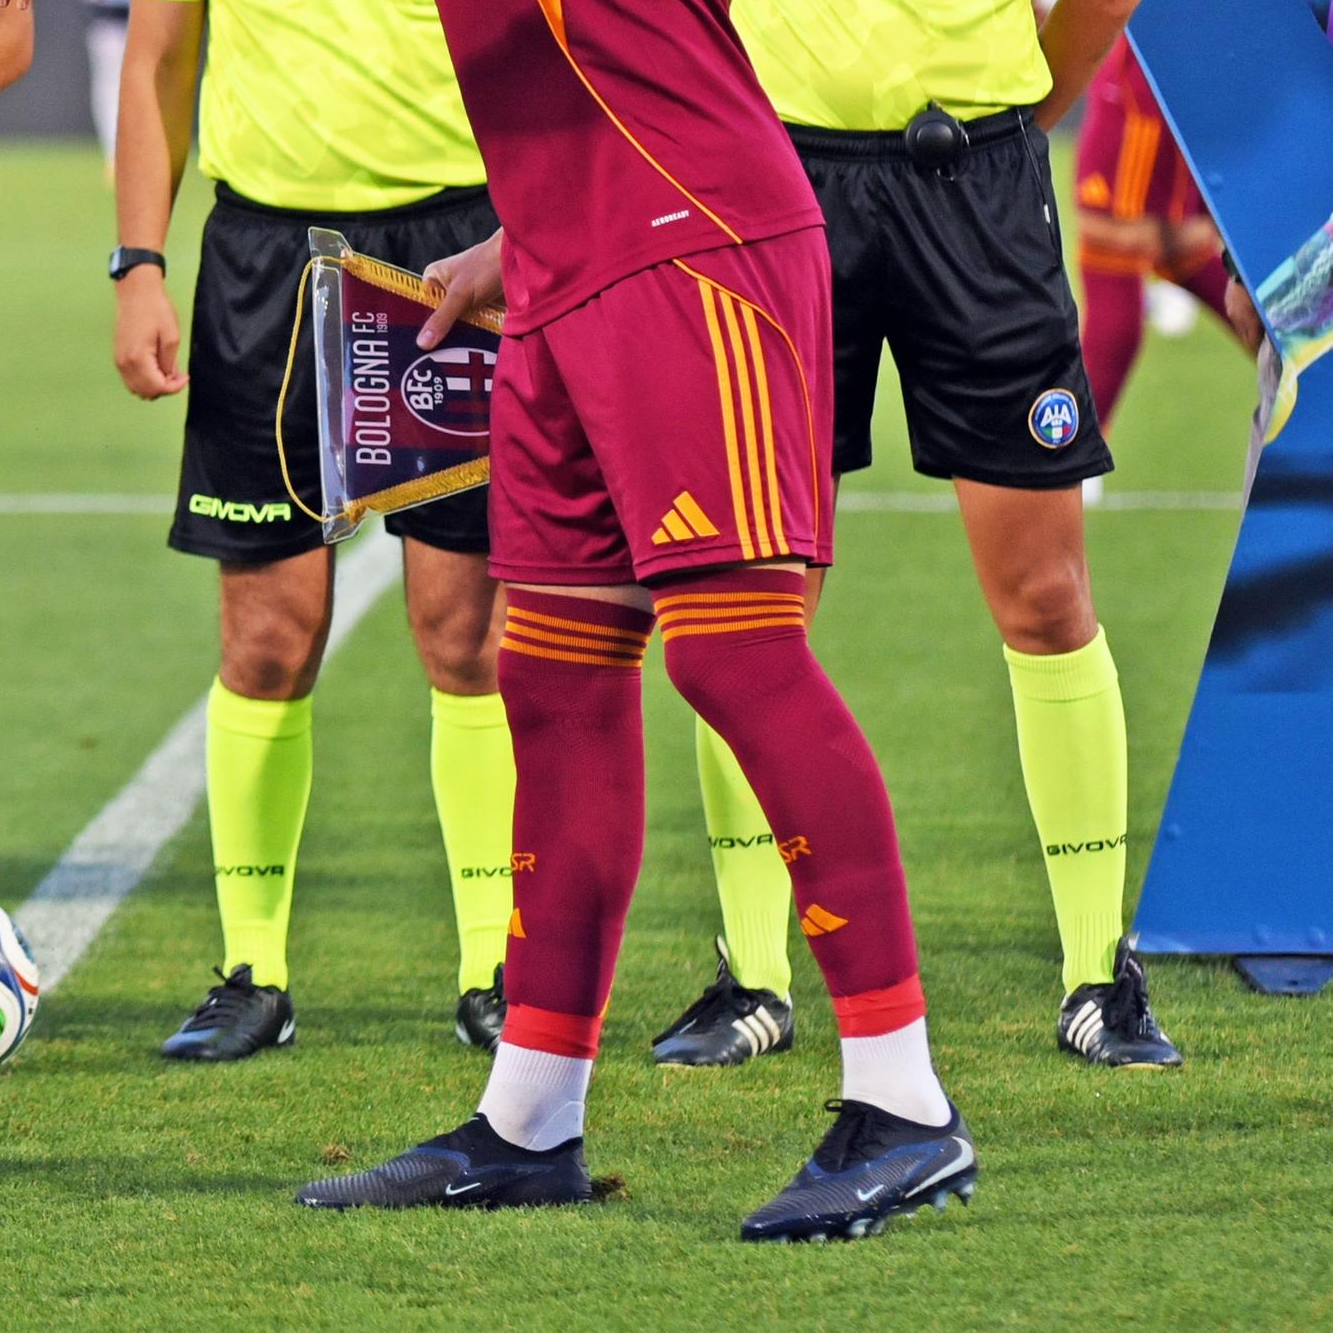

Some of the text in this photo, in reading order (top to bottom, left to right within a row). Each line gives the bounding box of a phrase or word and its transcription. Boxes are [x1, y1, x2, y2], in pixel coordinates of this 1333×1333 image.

[376, 312, 388, 334] 1909
[352, 311, 392, 465] BOLOGNA FC
[406, 368, 434, 411] BFC
[433, 376, 444, 405] 1909
[189, 493, 291, 524] GIVOVA
